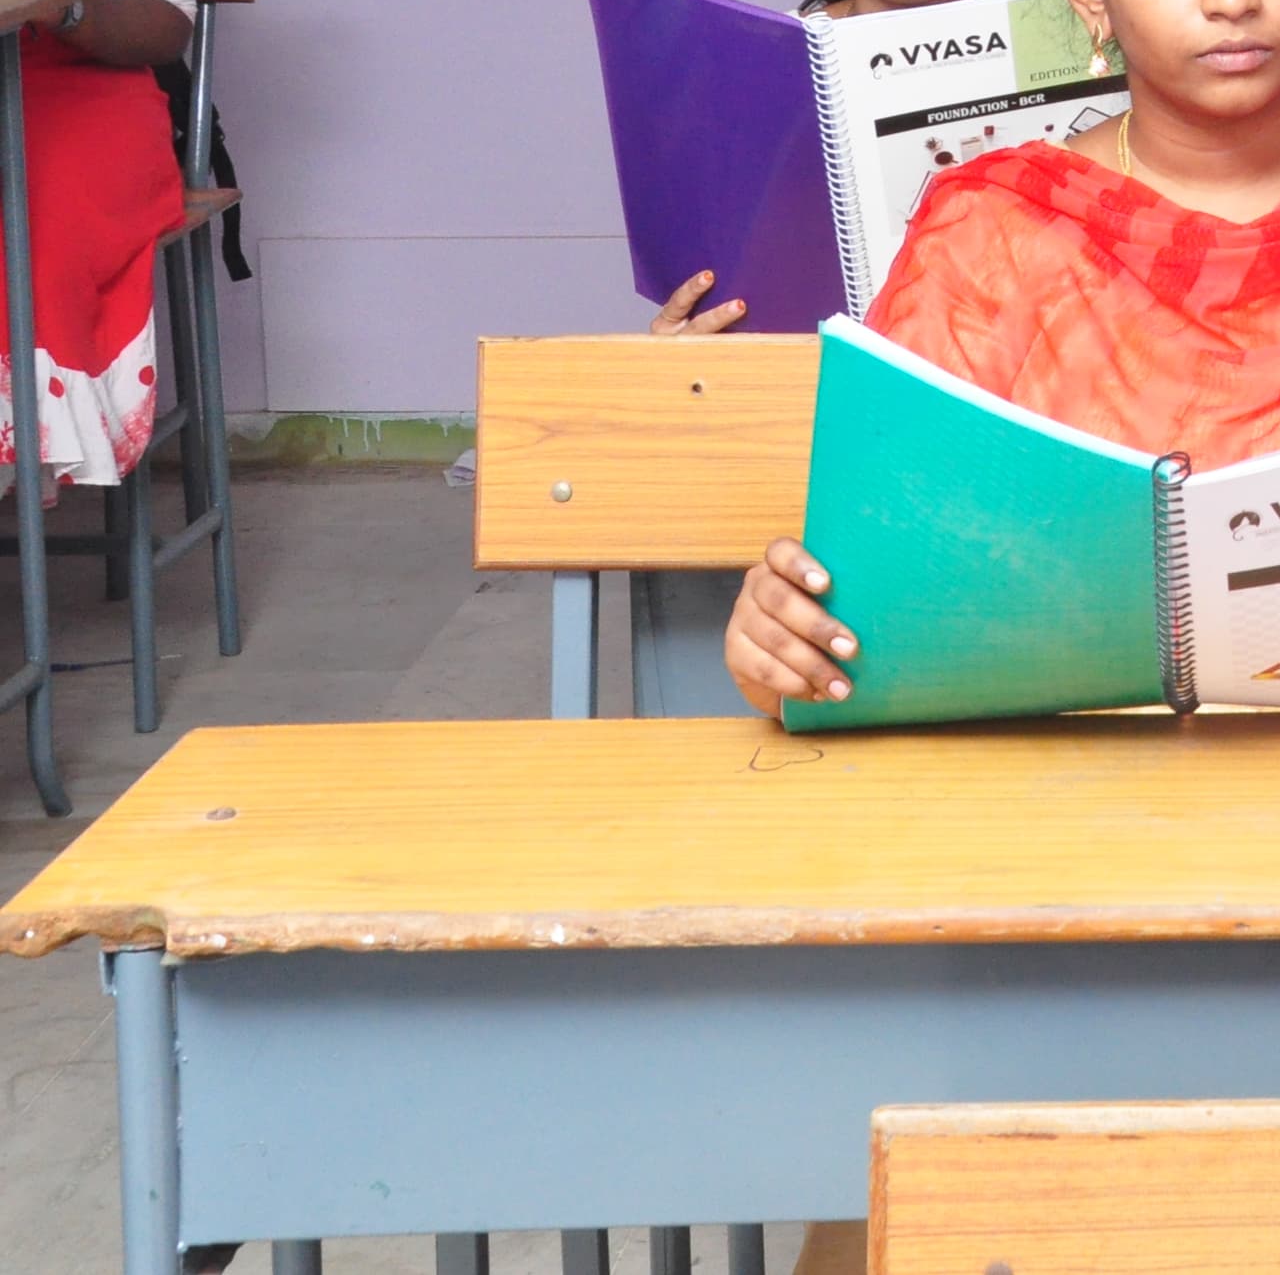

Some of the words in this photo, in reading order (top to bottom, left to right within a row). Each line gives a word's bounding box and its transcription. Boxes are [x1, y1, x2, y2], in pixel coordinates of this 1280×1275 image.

[899, 31, 1007, 66] VYASA
[1029, 65, 1081, 83] EDITION
[927, 99, 1009, 124] FOUNDATION
[1019, 93, 1046, 107] BCR
